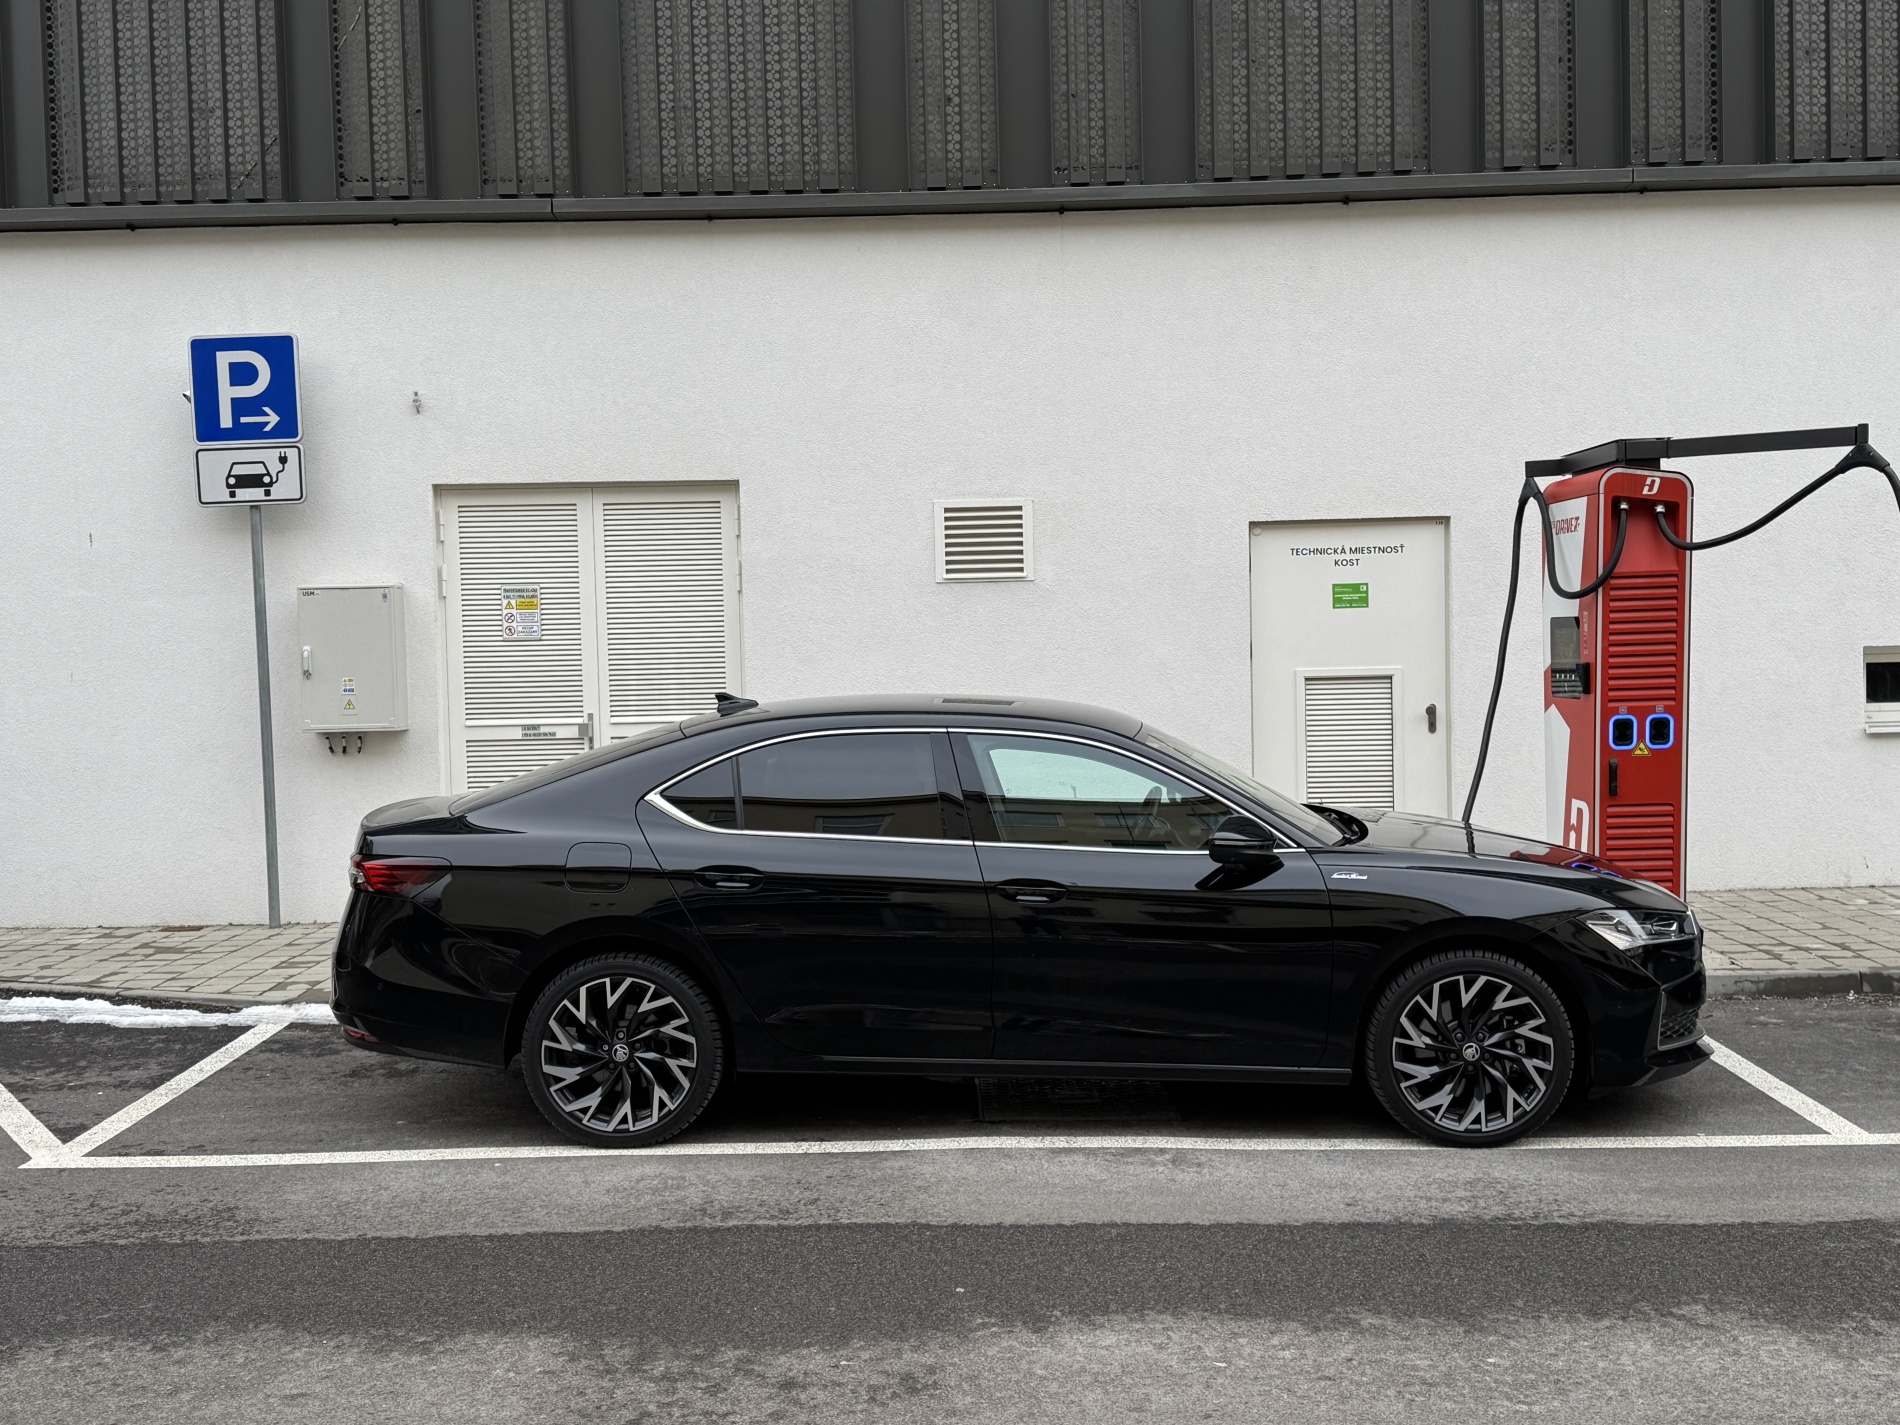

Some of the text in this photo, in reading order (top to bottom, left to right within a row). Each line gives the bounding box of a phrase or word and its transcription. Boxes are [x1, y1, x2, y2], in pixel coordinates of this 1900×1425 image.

[215, 350, 271, 429] P
[1290, 544, 1405, 556] TECHNICKÁ MIESTNOSŤ
[1334, 558, 1360, 567] KOST
